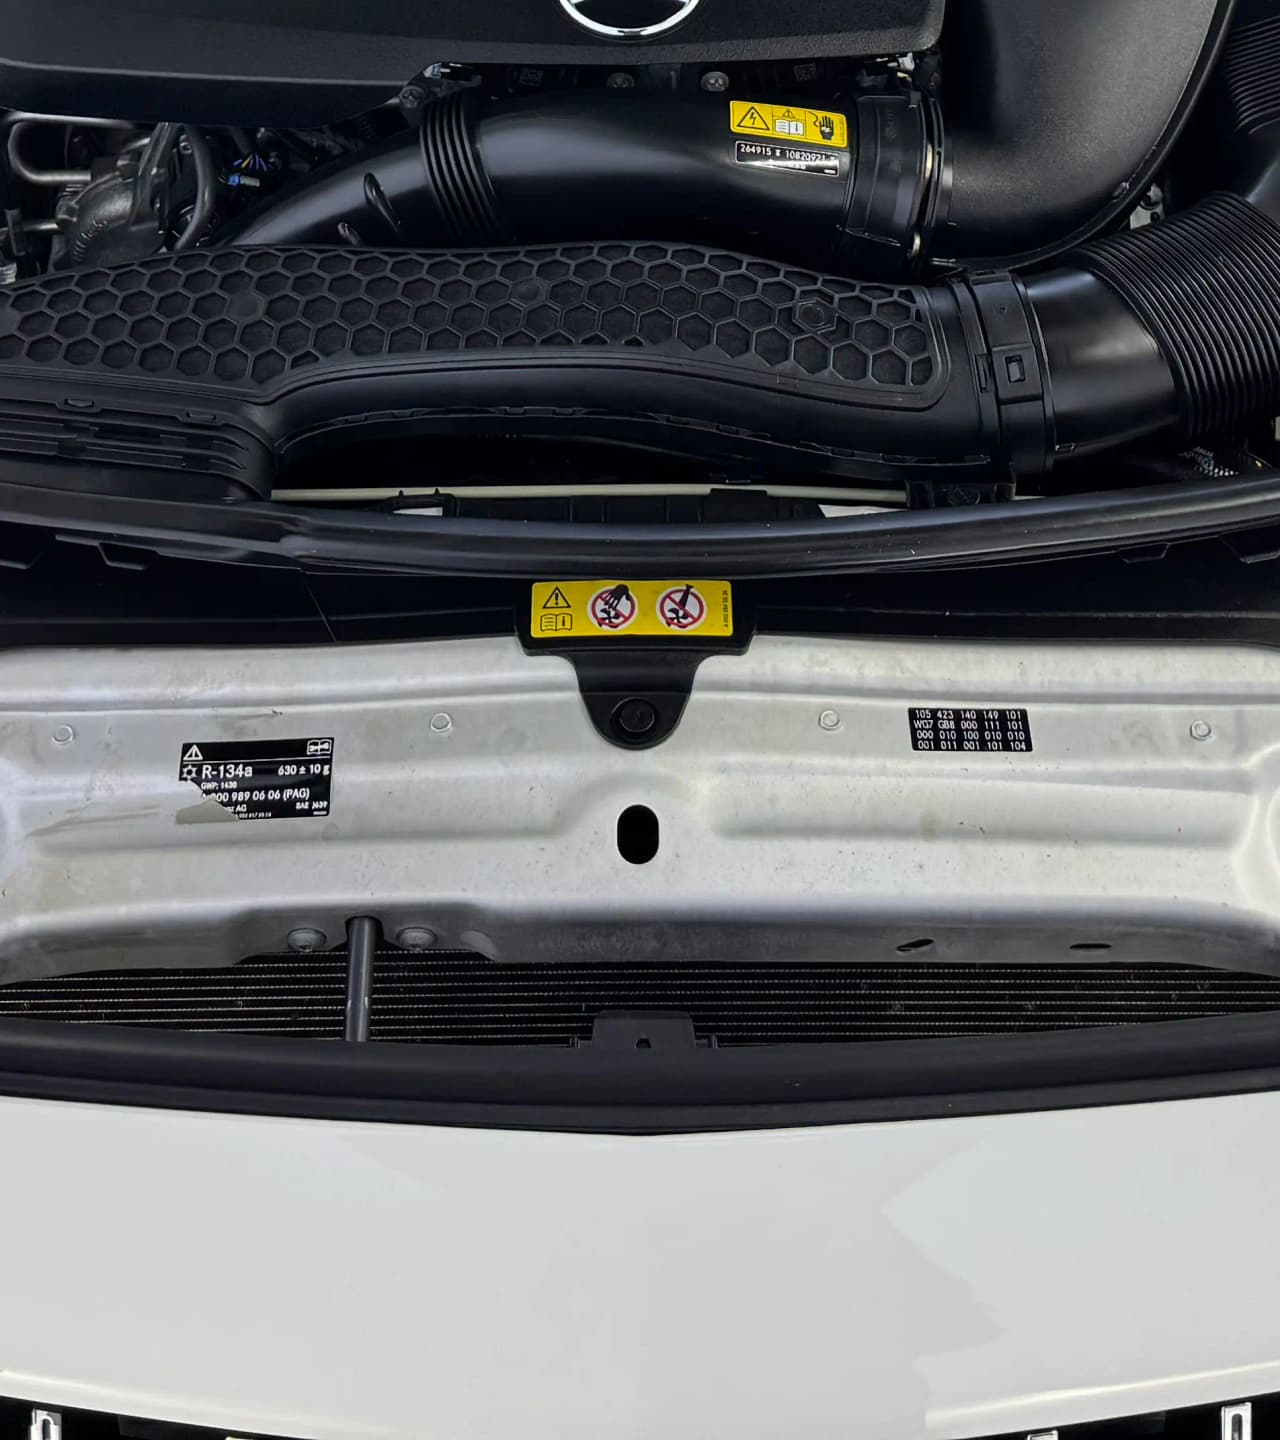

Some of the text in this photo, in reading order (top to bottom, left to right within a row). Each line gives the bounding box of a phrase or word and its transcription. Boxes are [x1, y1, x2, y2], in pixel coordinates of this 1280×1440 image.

[740, 144, 772, 156] 264915
[915, 710, 931, 718] 105
[937, 710, 954, 719] 423
[1006, 711, 1021, 720] 101
[960, 721, 977, 729] 000
[984, 721, 1000, 730] 111
[1007, 721, 1023, 730] 101
[916, 731, 1025, 740] 000 010 100 010 010
[917, 741, 934, 750] 001
[940, 741, 957, 750] 011
[963, 741, 980, 750] 001
[987, 741, 1002, 750] 101
[202, 764, 253, 779] R-134a
[278, 765, 297, 776] 630
[309, 764, 321, 774] 10
[323, 766, 330, 775] g
[231, 791, 250, 802] 989
[253, 791, 265, 801] 06
[268, 790, 281, 800] 06
[283, 788, 310, 801] (PAG)
[235, 804, 247, 812] AG
